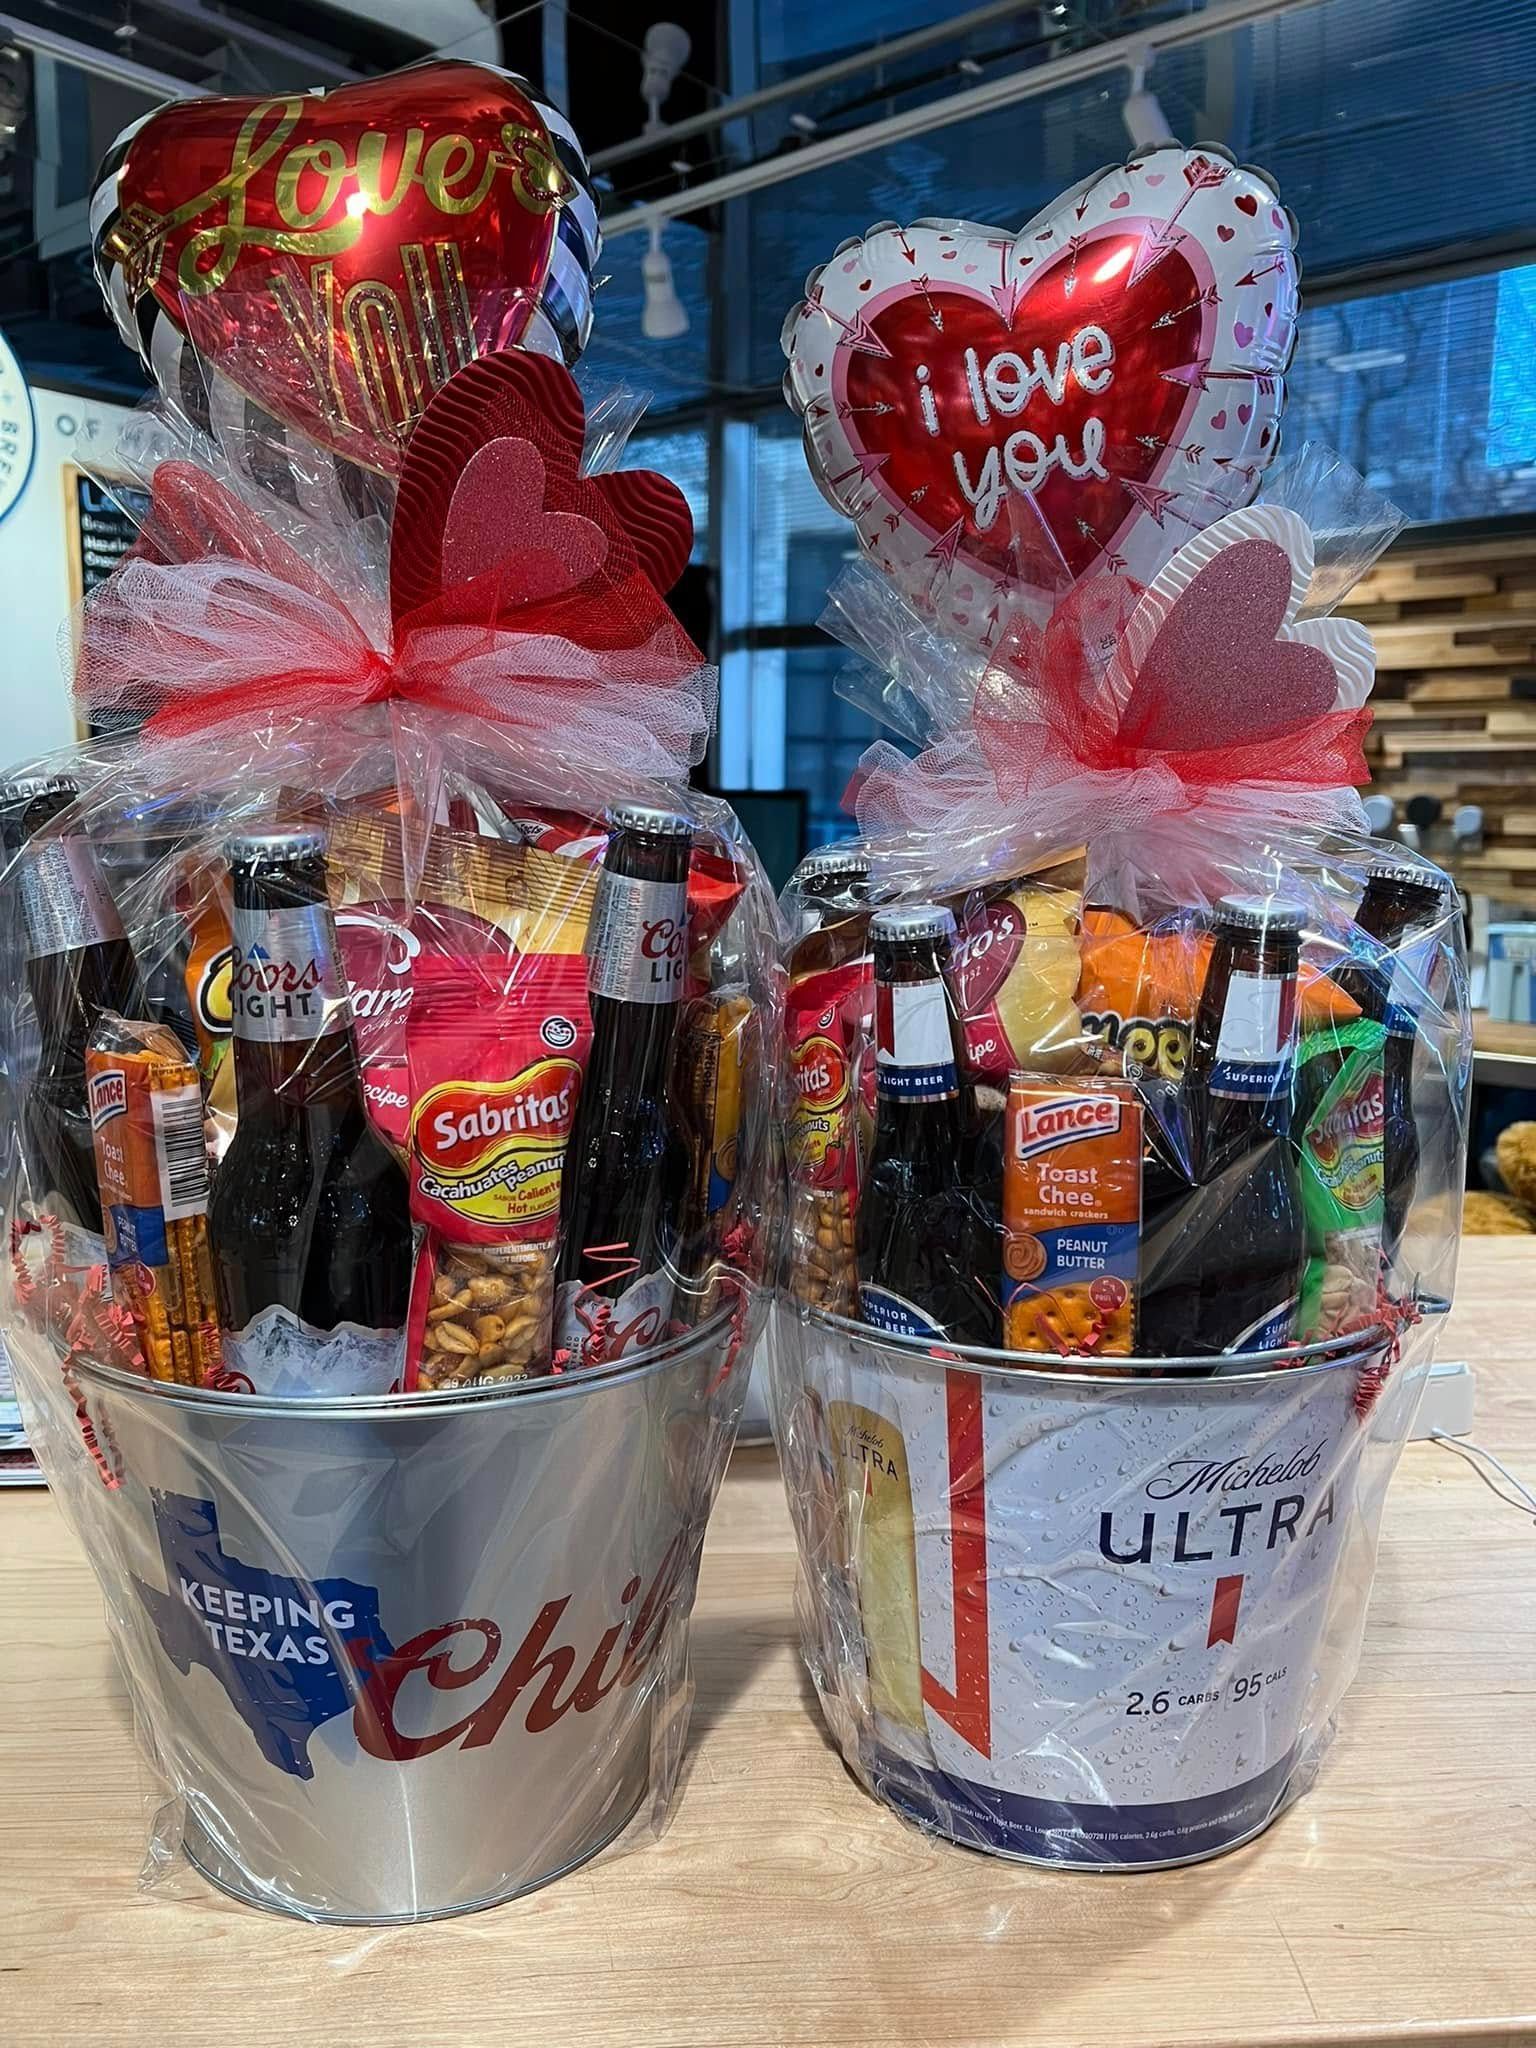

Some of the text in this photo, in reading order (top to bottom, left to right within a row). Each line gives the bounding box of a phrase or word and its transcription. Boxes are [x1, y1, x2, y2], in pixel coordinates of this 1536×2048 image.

[178, 97, 505, 296] Love
[914, 323, 1117, 436] i love
[953, 416, 1112, 531] you
[90, 1078, 124, 1116] Lance
[883, 1074, 944, 1087] LIGHT BEER
[433, 1088, 570, 1150] Sabritas
[1022, 1100, 1115, 1146] Lance
[100, 1135, 124, 1163] Toast
[419, 1160, 519, 1200] Cacahuates
[1037, 1162, 1098, 1184] Toast
[507, 1202, 529, 1215] Hot
[1023, 1206, 1109, 1220] sandwich crackers
[1056, 1238, 1109, 1254] PEANUT
[1056, 1254, 1106, 1270] BUTTER
[885, 1321, 916, 1336] BEER
[1146, 1438, 1328, 1500] Michelob
[1099, 1480, 1335, 1565] ULTRA
[181, 1576, 356, 1630] KEEPING
[204, 1619, 330, 1666] TEXAS
[1125, 1666, 1288, 1716] 2.6 CARBS 95 CALS
